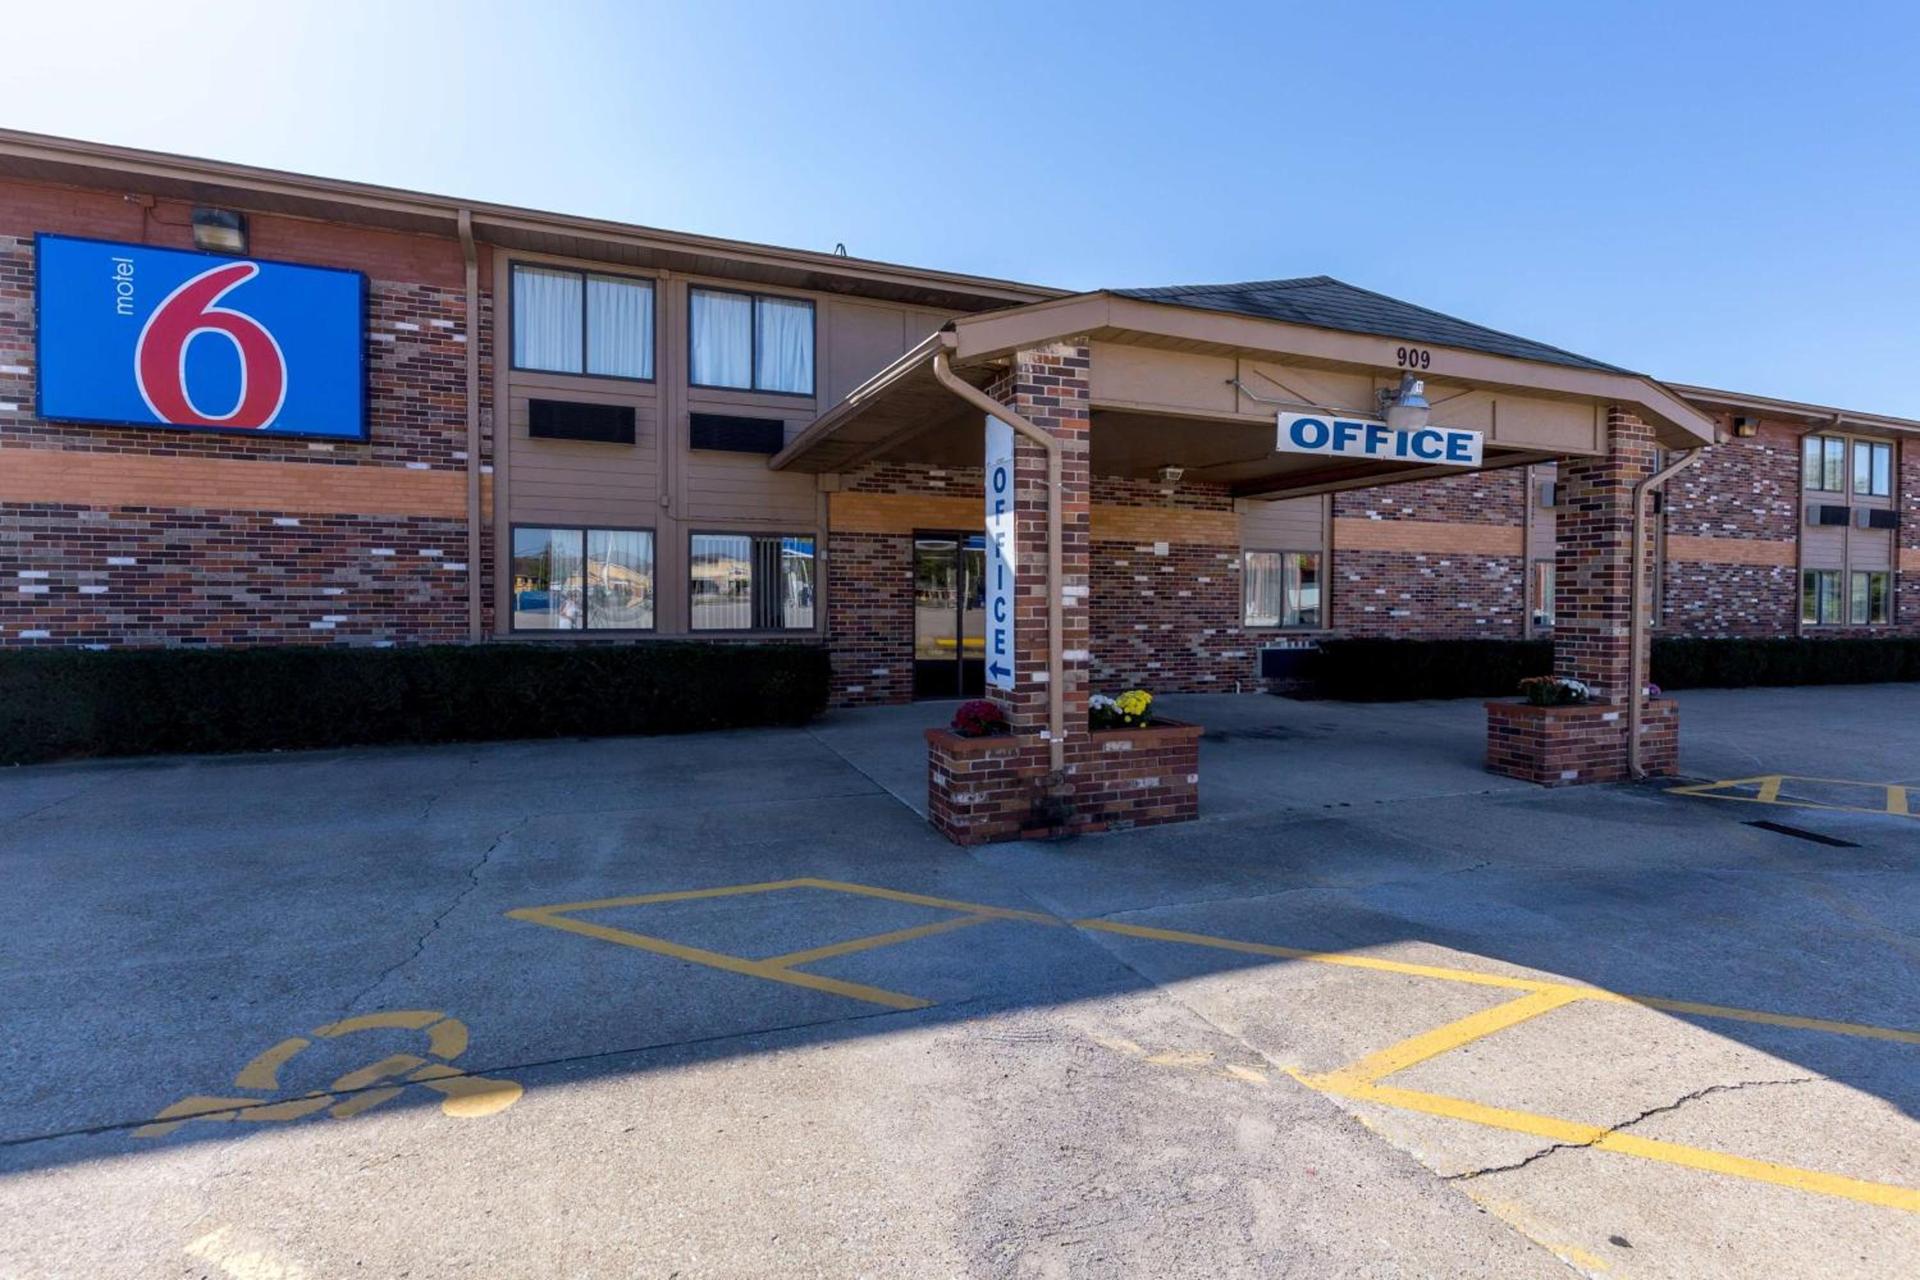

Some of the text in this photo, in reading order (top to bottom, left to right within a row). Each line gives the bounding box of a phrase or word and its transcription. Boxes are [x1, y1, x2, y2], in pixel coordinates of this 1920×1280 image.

[112, 257, 288, 430] motel 6
[1396, 346, 1431, 370] 909
[1289, 417, 1474, 462] OFFICE
[992, 466, 1007, 655] OFFICE
